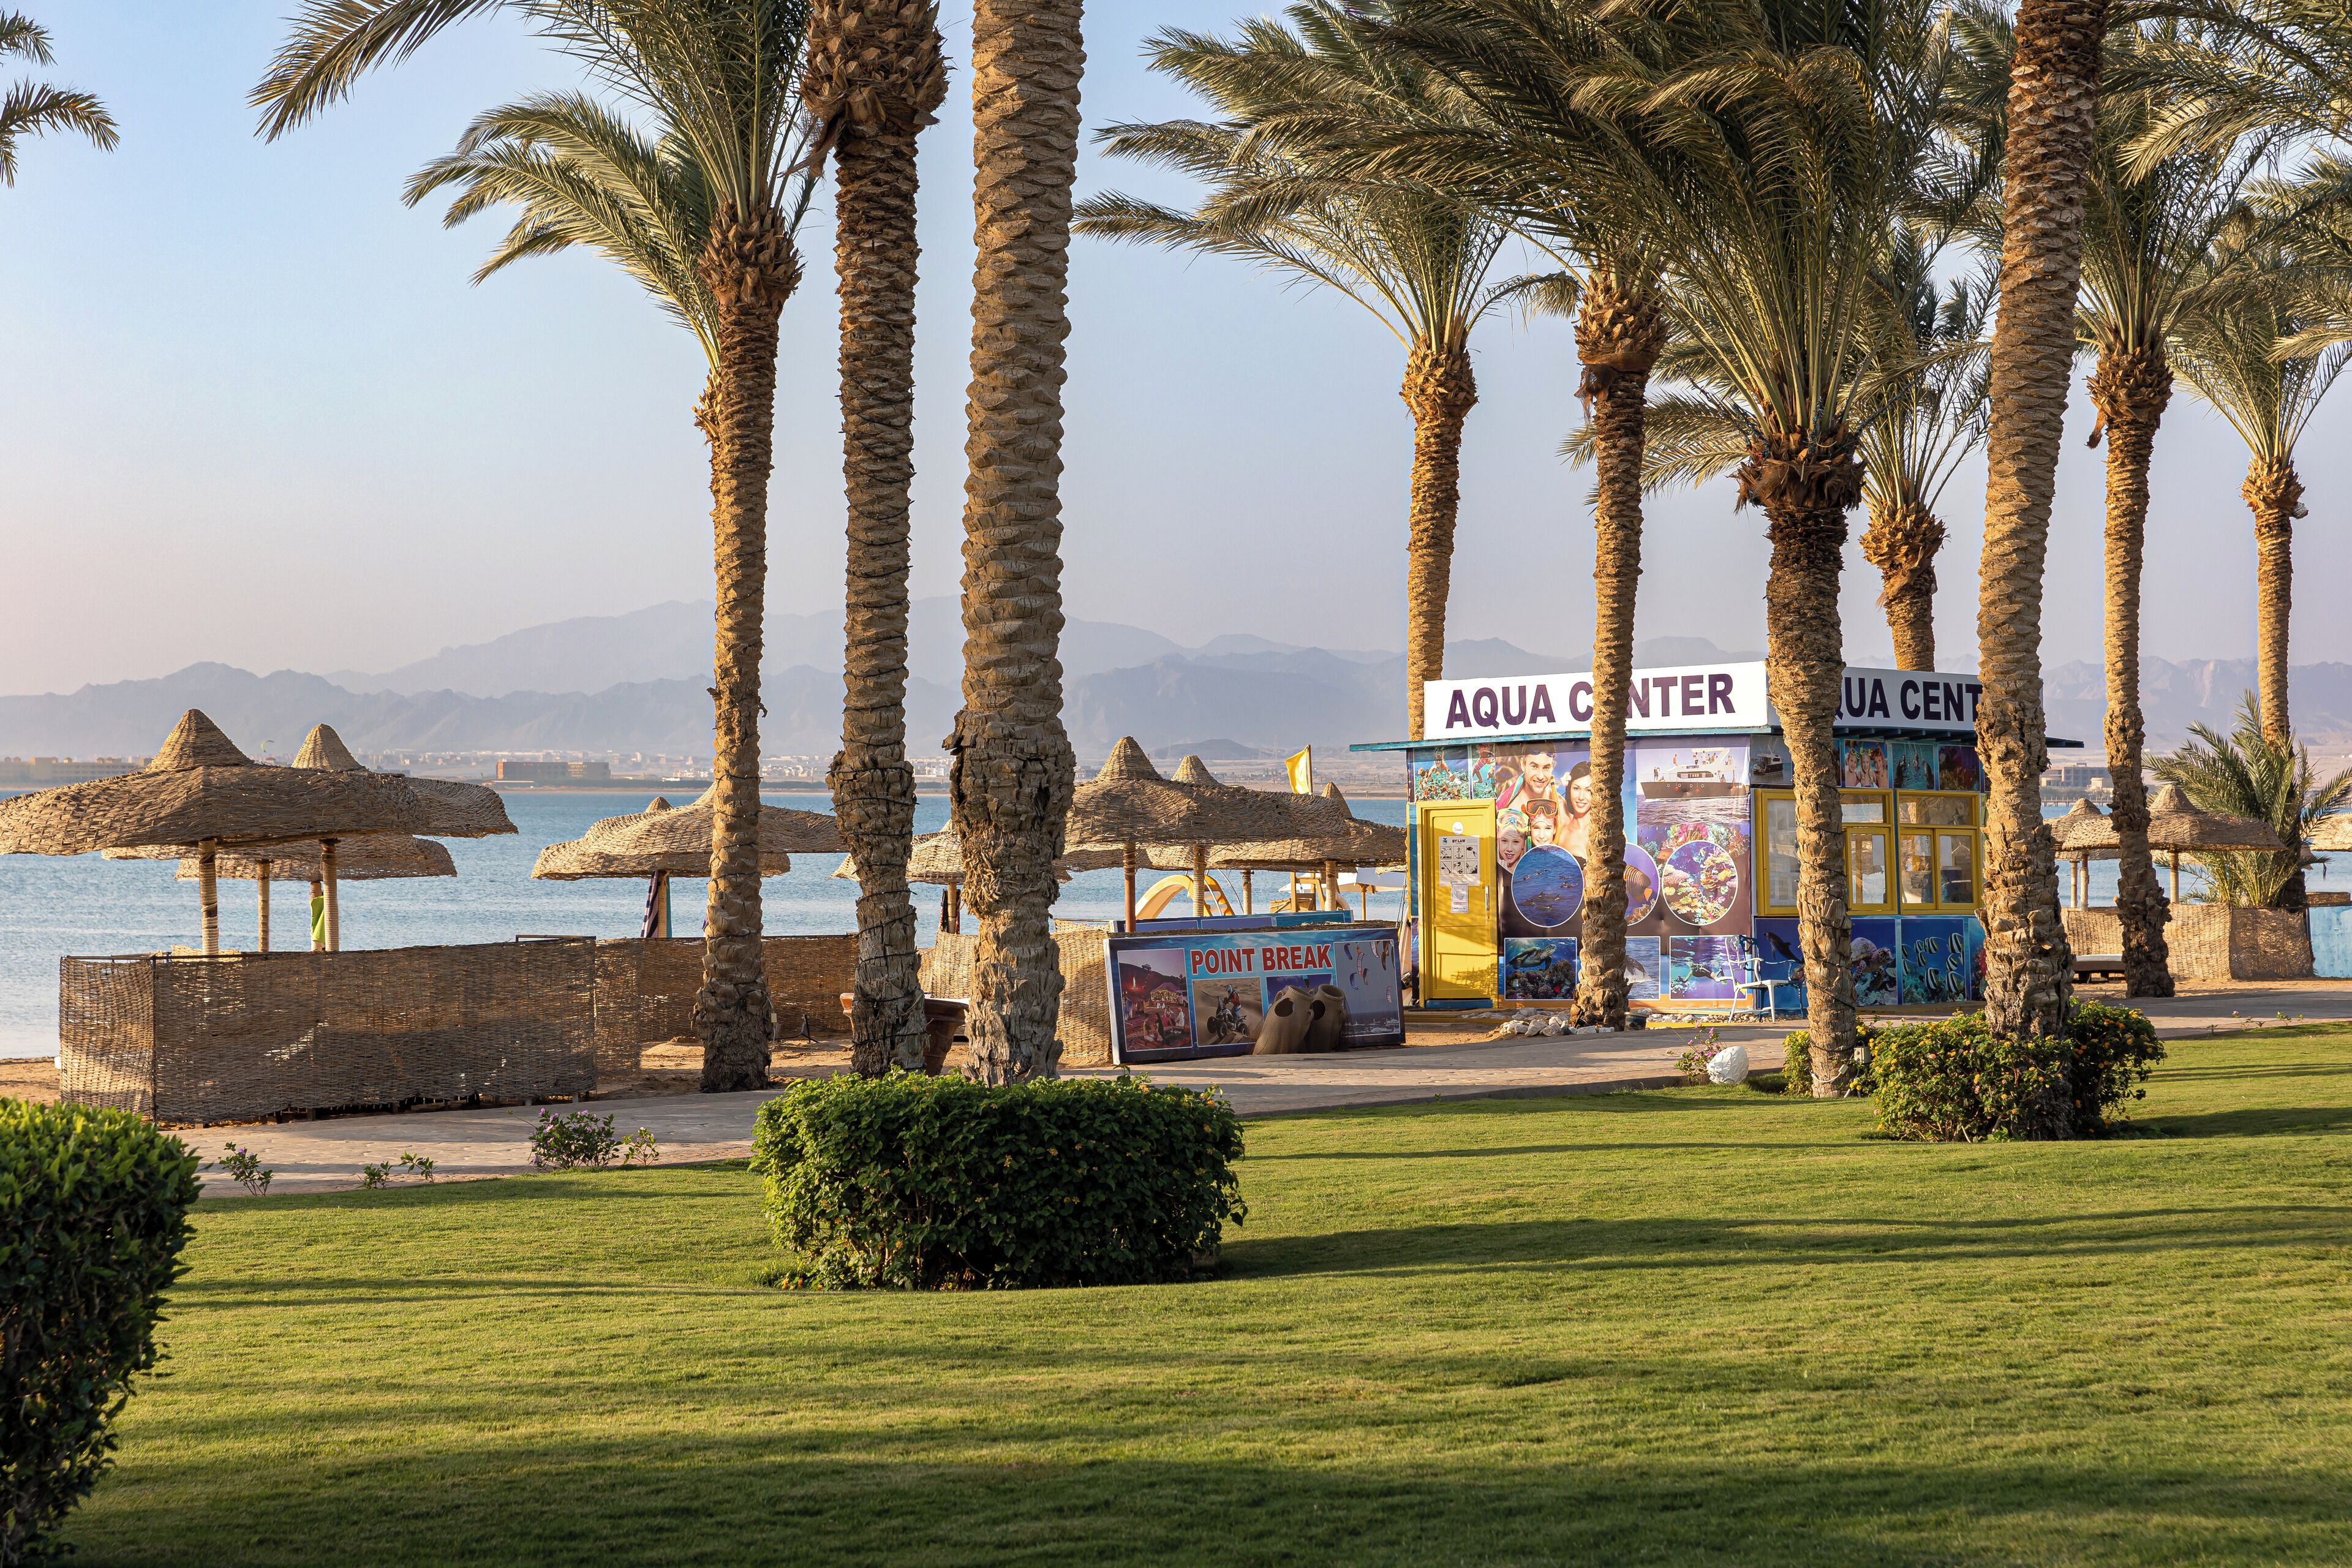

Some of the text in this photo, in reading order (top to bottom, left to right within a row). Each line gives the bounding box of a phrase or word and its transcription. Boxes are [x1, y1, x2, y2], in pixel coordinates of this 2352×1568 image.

[1446, 674, 1735, 729] AQUA CNTER
[1835, 677, 1983, 722] UA CENT
[1191, 944, 1333, 974] POINT BREAK
